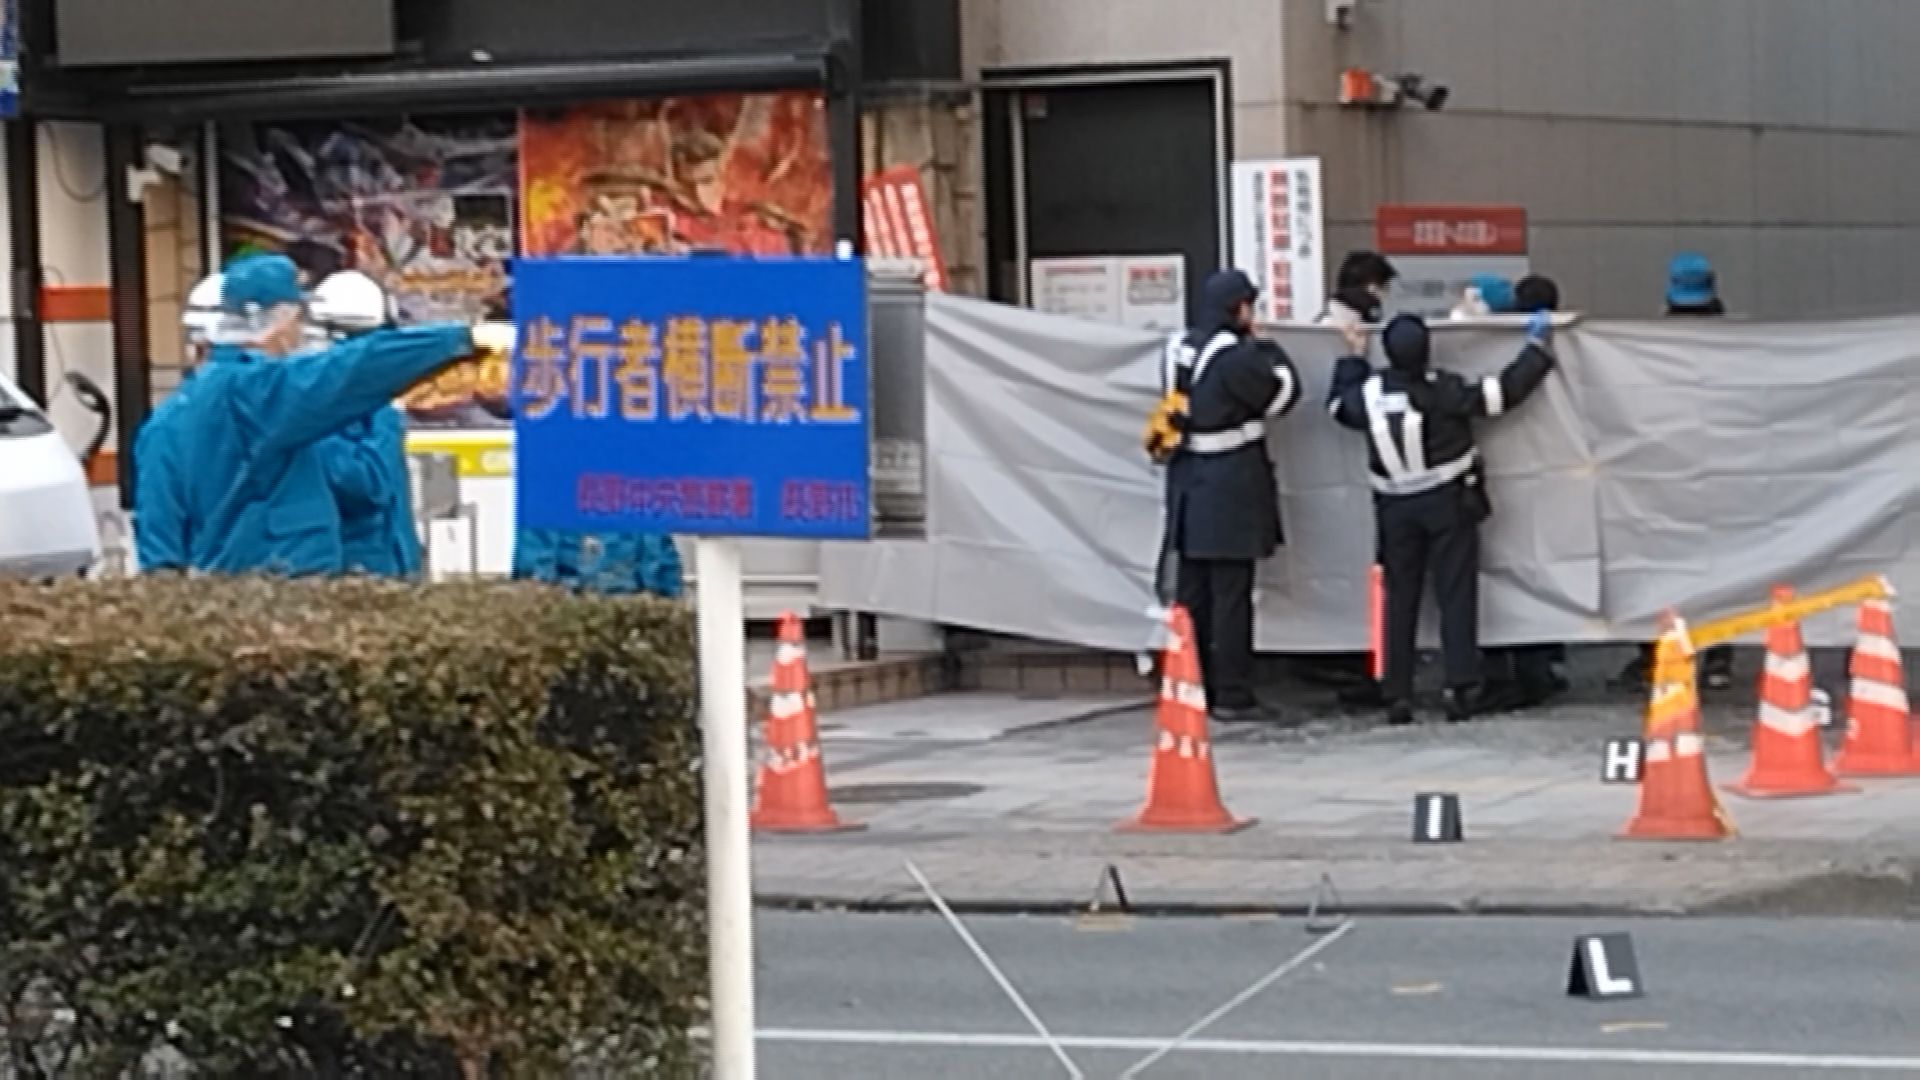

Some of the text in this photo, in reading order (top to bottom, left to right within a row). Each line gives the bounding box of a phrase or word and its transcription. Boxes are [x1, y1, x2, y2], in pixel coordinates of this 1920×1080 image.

[522, 314, 861, 424] 歩行者横断禁止
[1605, 741, 1640, 780] H
[1588, 938, 1633, 994] L
